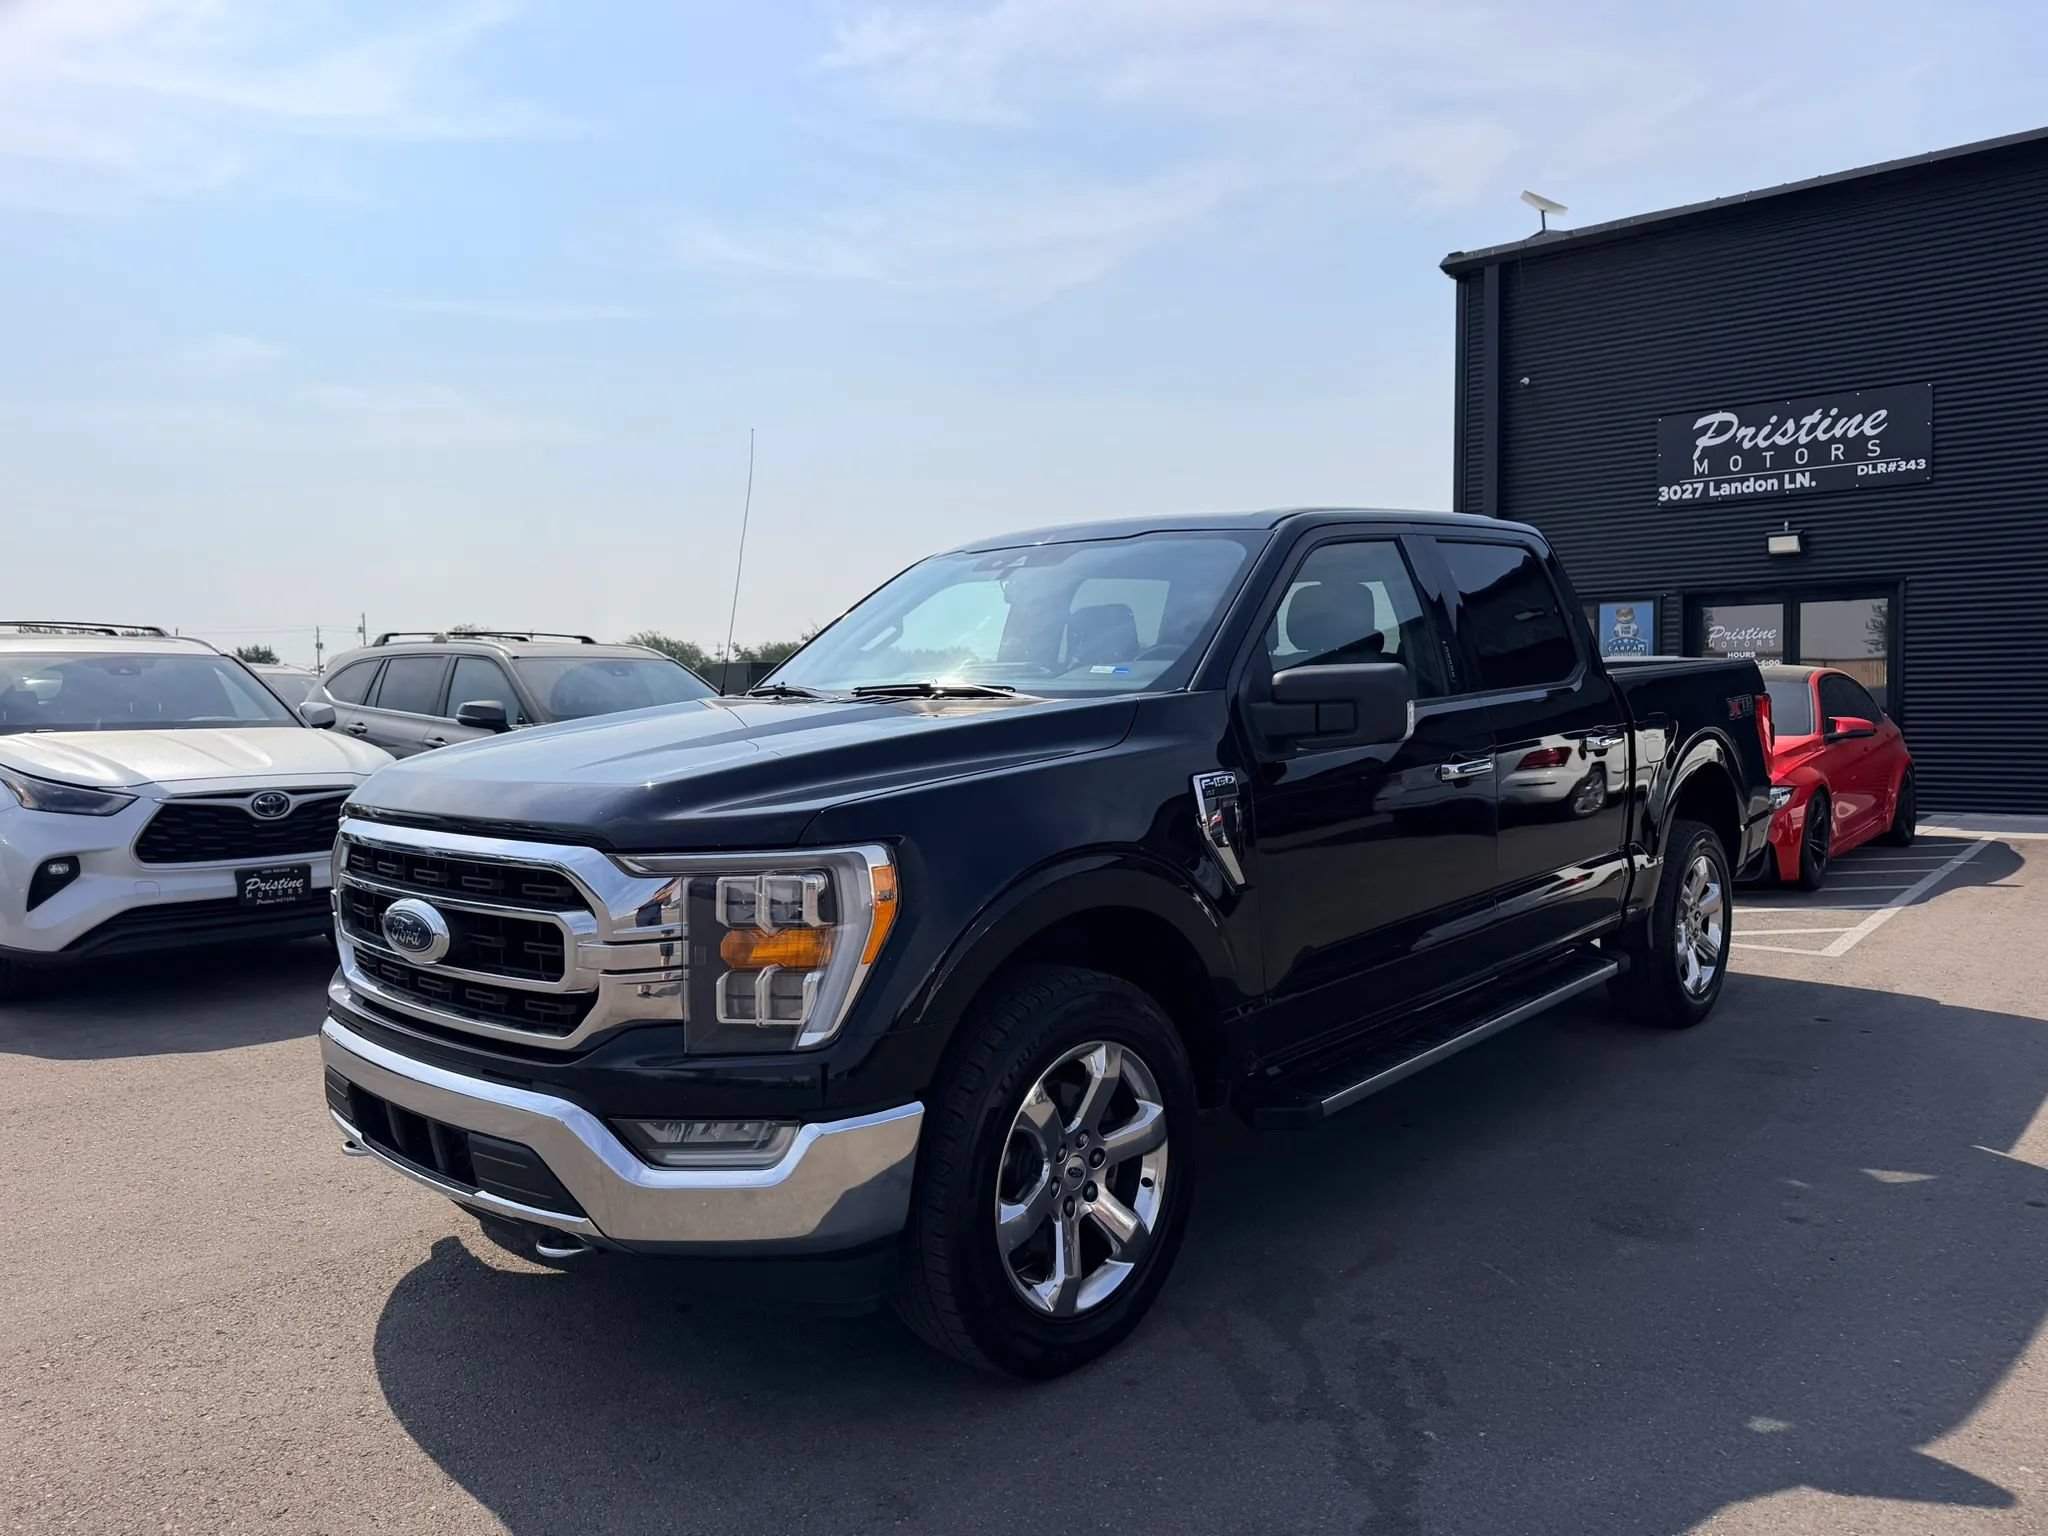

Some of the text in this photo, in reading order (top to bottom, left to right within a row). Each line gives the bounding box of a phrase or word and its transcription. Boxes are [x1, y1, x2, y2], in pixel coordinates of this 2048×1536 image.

[1692, 407, 1888, 460] Pristine
[1693, 439, 1881, 476] MOTORS
[1857, 458, 1927, 476] DLR#343
[1658, 472, 1817, 501] 3027 Landon LN.
[1708, 625, 1777, 643] Pristine
[1708, 639, 1775, 649] MOTORS
[1727, 651, 1756, 659] HOURS
[1201, 775, 1235, 789] F-150
[245, 877, 304, 895] Pristine
[389, 914, 421, 946] Ford
